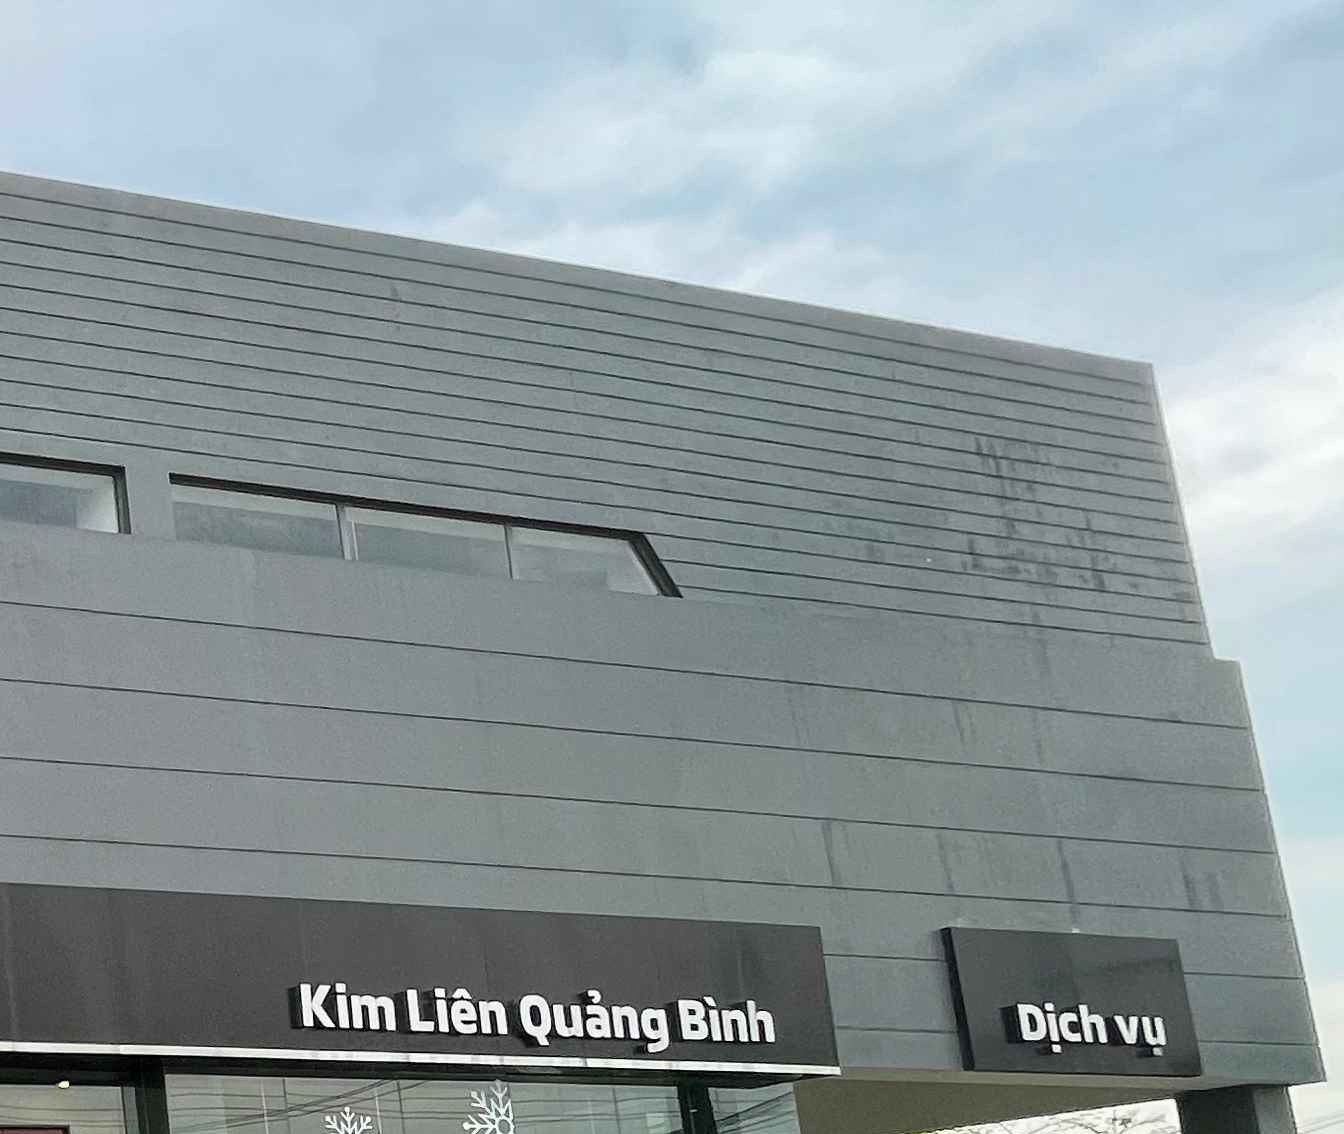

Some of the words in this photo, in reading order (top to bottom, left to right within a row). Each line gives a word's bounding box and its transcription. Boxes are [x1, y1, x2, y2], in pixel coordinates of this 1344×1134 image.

[299, 983, 397, 1032] Kim
[406, 987, 510, 1036] Liên
[519, 990, 671, 1053] Quảng
[677, 996, 777, 1044] Bình
[1016, 1002, 1108, 1054] Dịch
[1113, 1015, 1168, 1057] vụ
